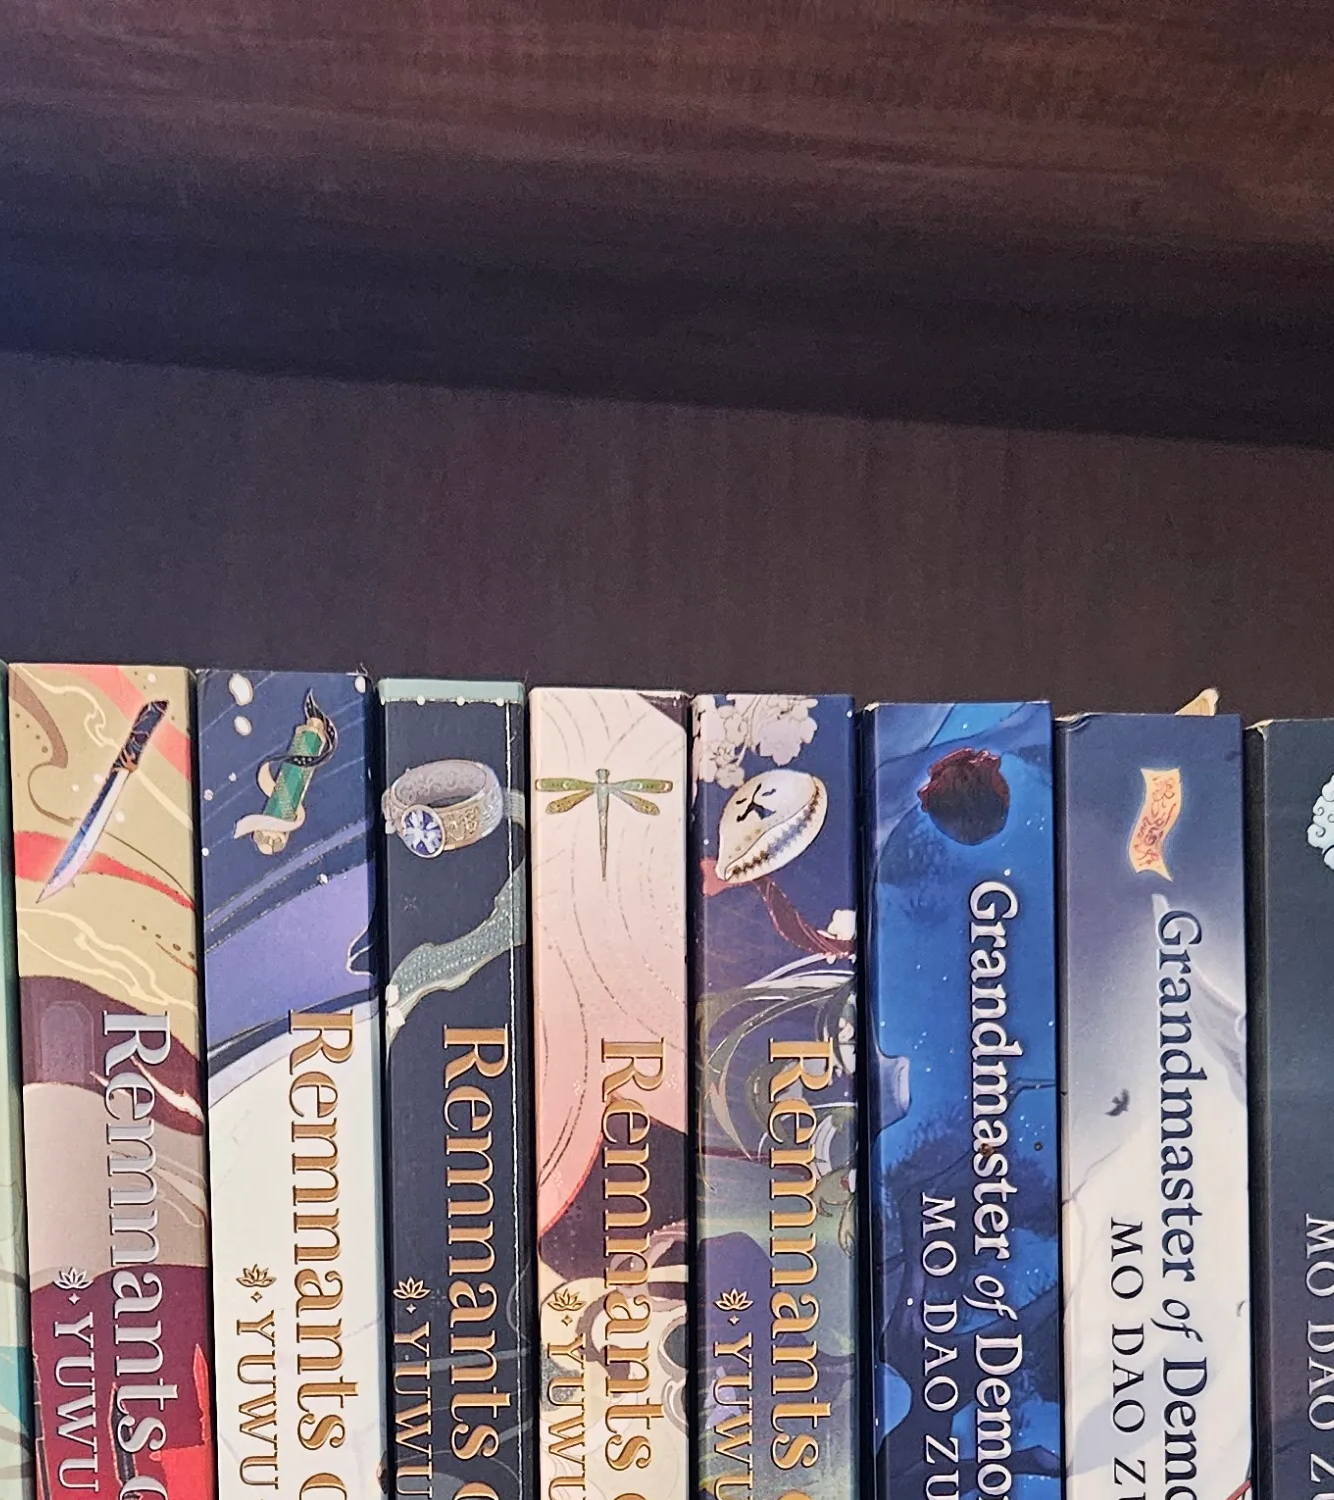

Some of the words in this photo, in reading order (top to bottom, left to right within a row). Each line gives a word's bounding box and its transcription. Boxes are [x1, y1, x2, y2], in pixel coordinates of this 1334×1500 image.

[103, 1010, 178, 1453] Remnants
[289, 1009, 358, 1450] Remnants
[443, 1024, 511, 1460] Remnants
[601, 1037, 667, 1470] Remnants
[769, 1037, 832, 1470] Remnants
[921, 1192, 957, 1277] MO
[970, 881, 1023, 1260] Grandmaster
[1158, 910, 1208, 1282] Grandmaster
[923, 1301, 960, 1412] DAO
[963, 1276, 1017, 1320] of
[1151, 1299, 1204, 1343] of
